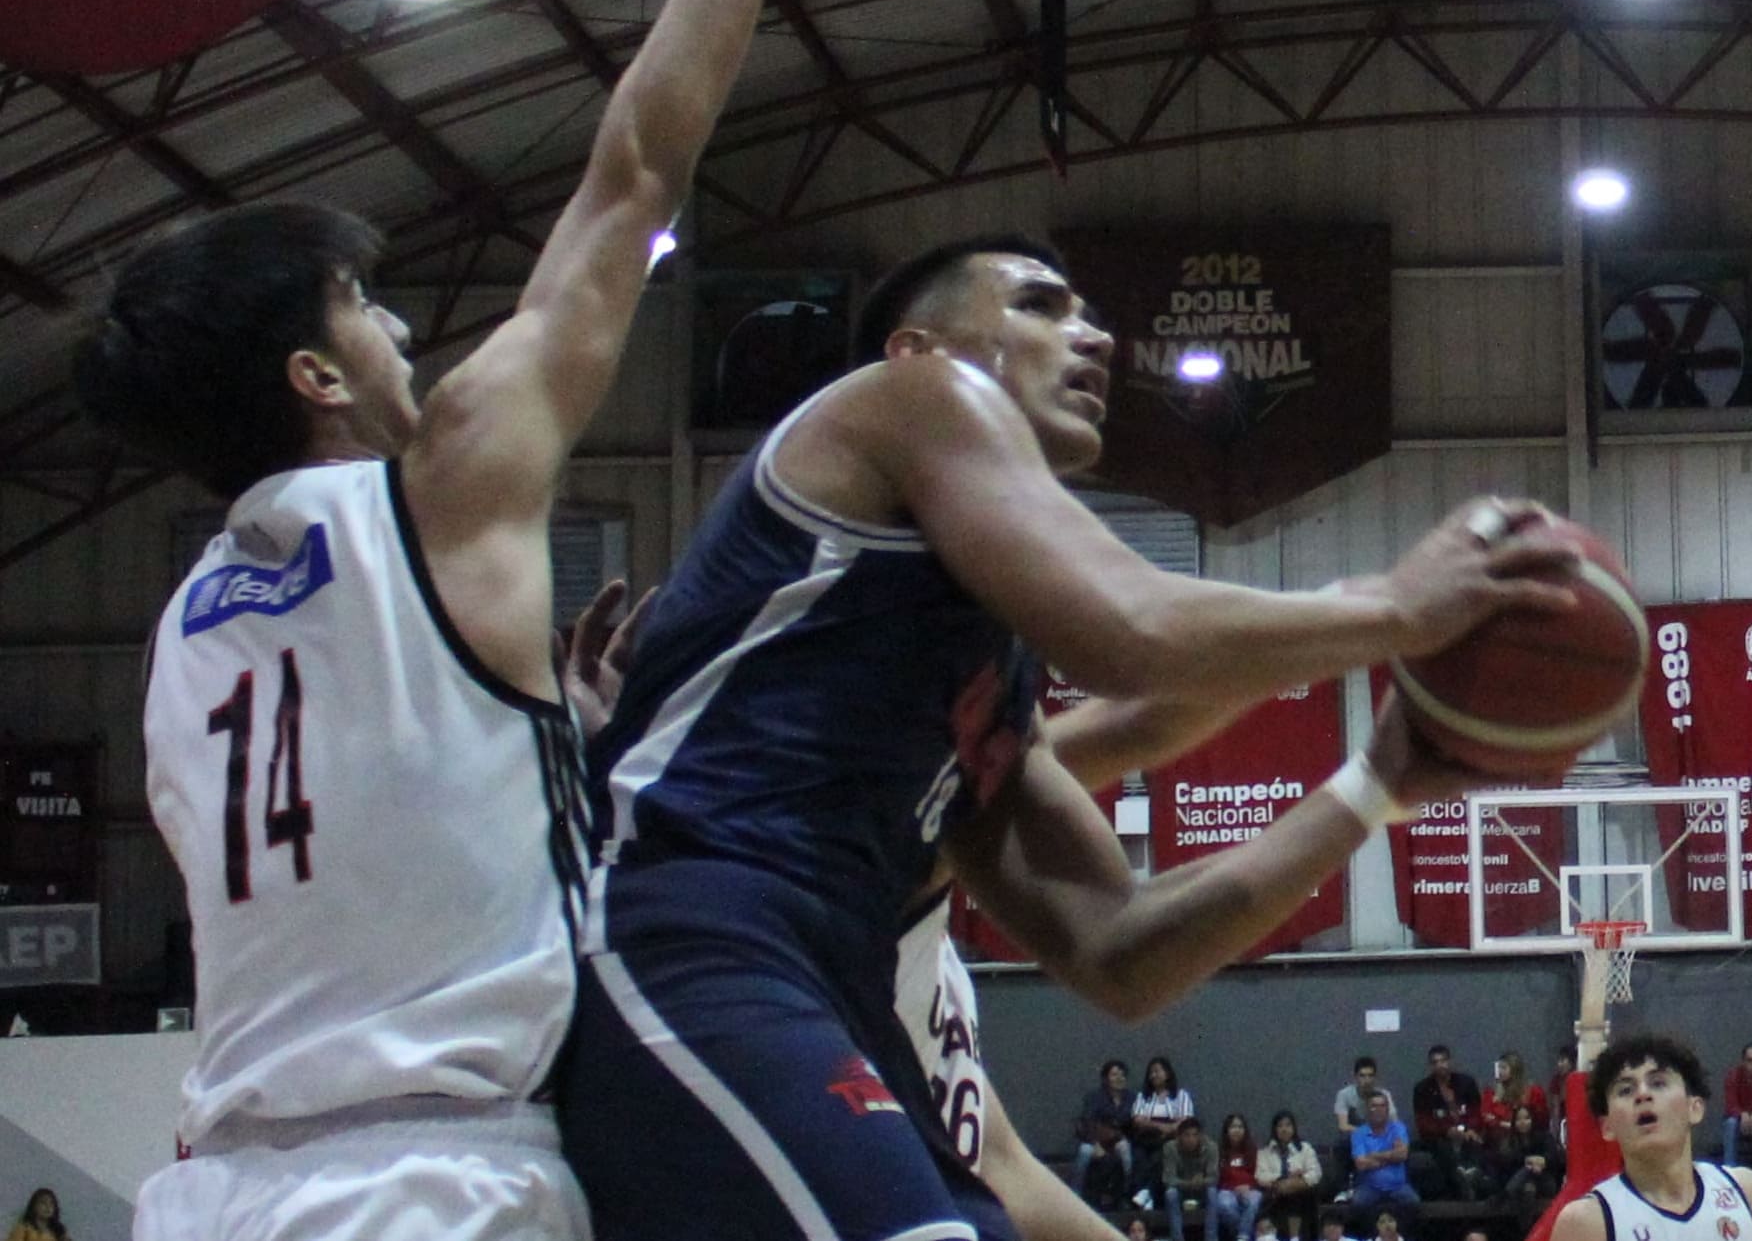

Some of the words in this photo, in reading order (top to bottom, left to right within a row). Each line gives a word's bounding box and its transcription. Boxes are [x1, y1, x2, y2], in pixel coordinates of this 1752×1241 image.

[1181, 254, 1263, 285] 2012
[1170, 290, 1274, 313] DOBLE
[1657, 622, 1692, 733] 1989
[208, 648, 314, 903] 14
[1175, 777, 1304, 806] Campeón
[16, 797, 82, 816] VISITA
[1176, 801, 1273, 826] Nacional
